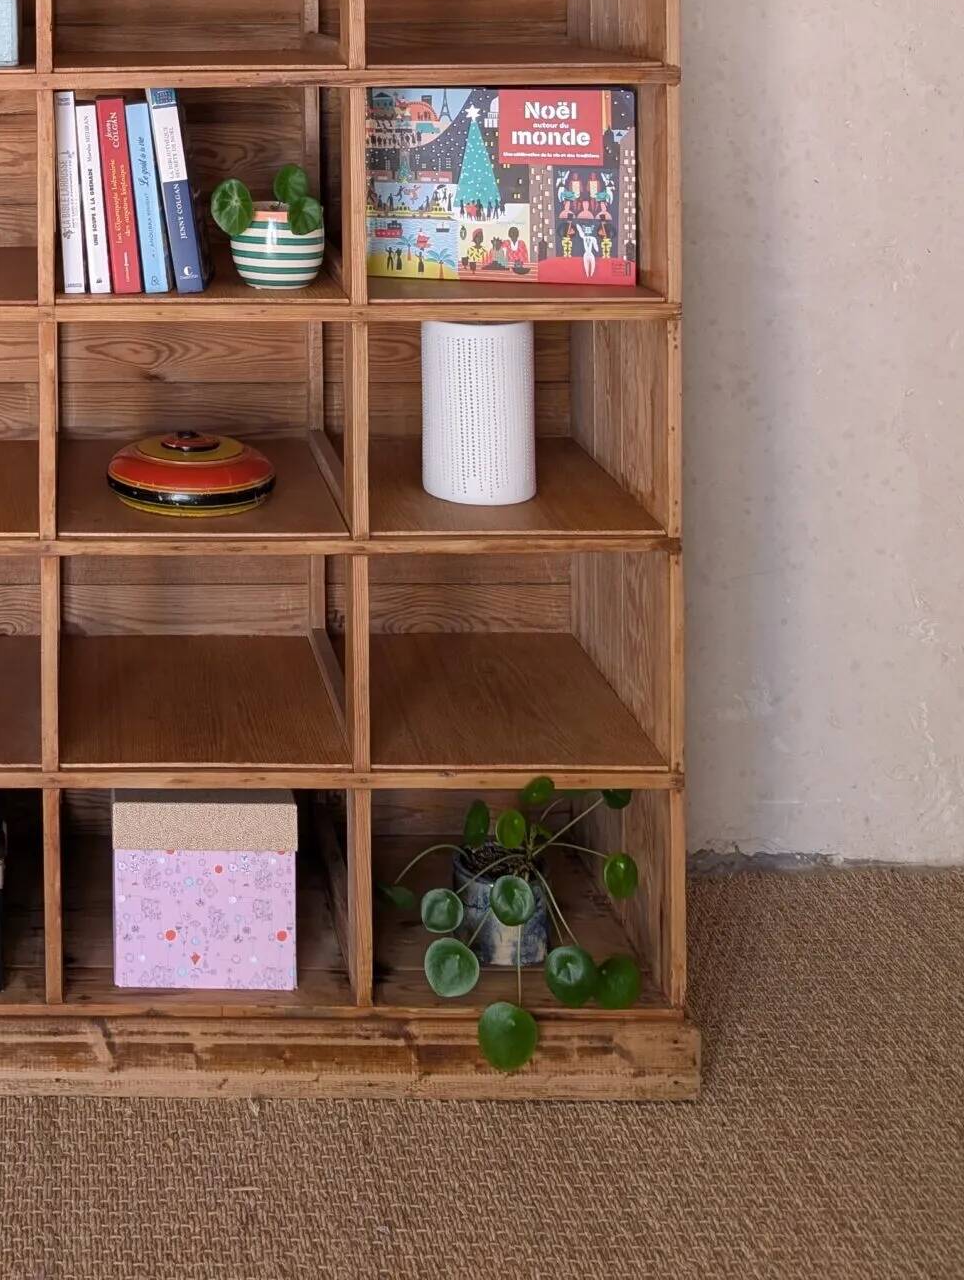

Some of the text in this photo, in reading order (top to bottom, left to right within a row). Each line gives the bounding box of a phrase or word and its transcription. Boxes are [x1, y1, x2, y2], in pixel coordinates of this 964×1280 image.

[524, 101, 577, 120] Noël
[110, 112, 120, 148] COLGAN
[511, 128, 591, 146] monde
[59, 160, 70, 196] LAROUSSE
[138, 175, 150, 186] Le
[173, 183, 188, 239] JENNY COLGAN
